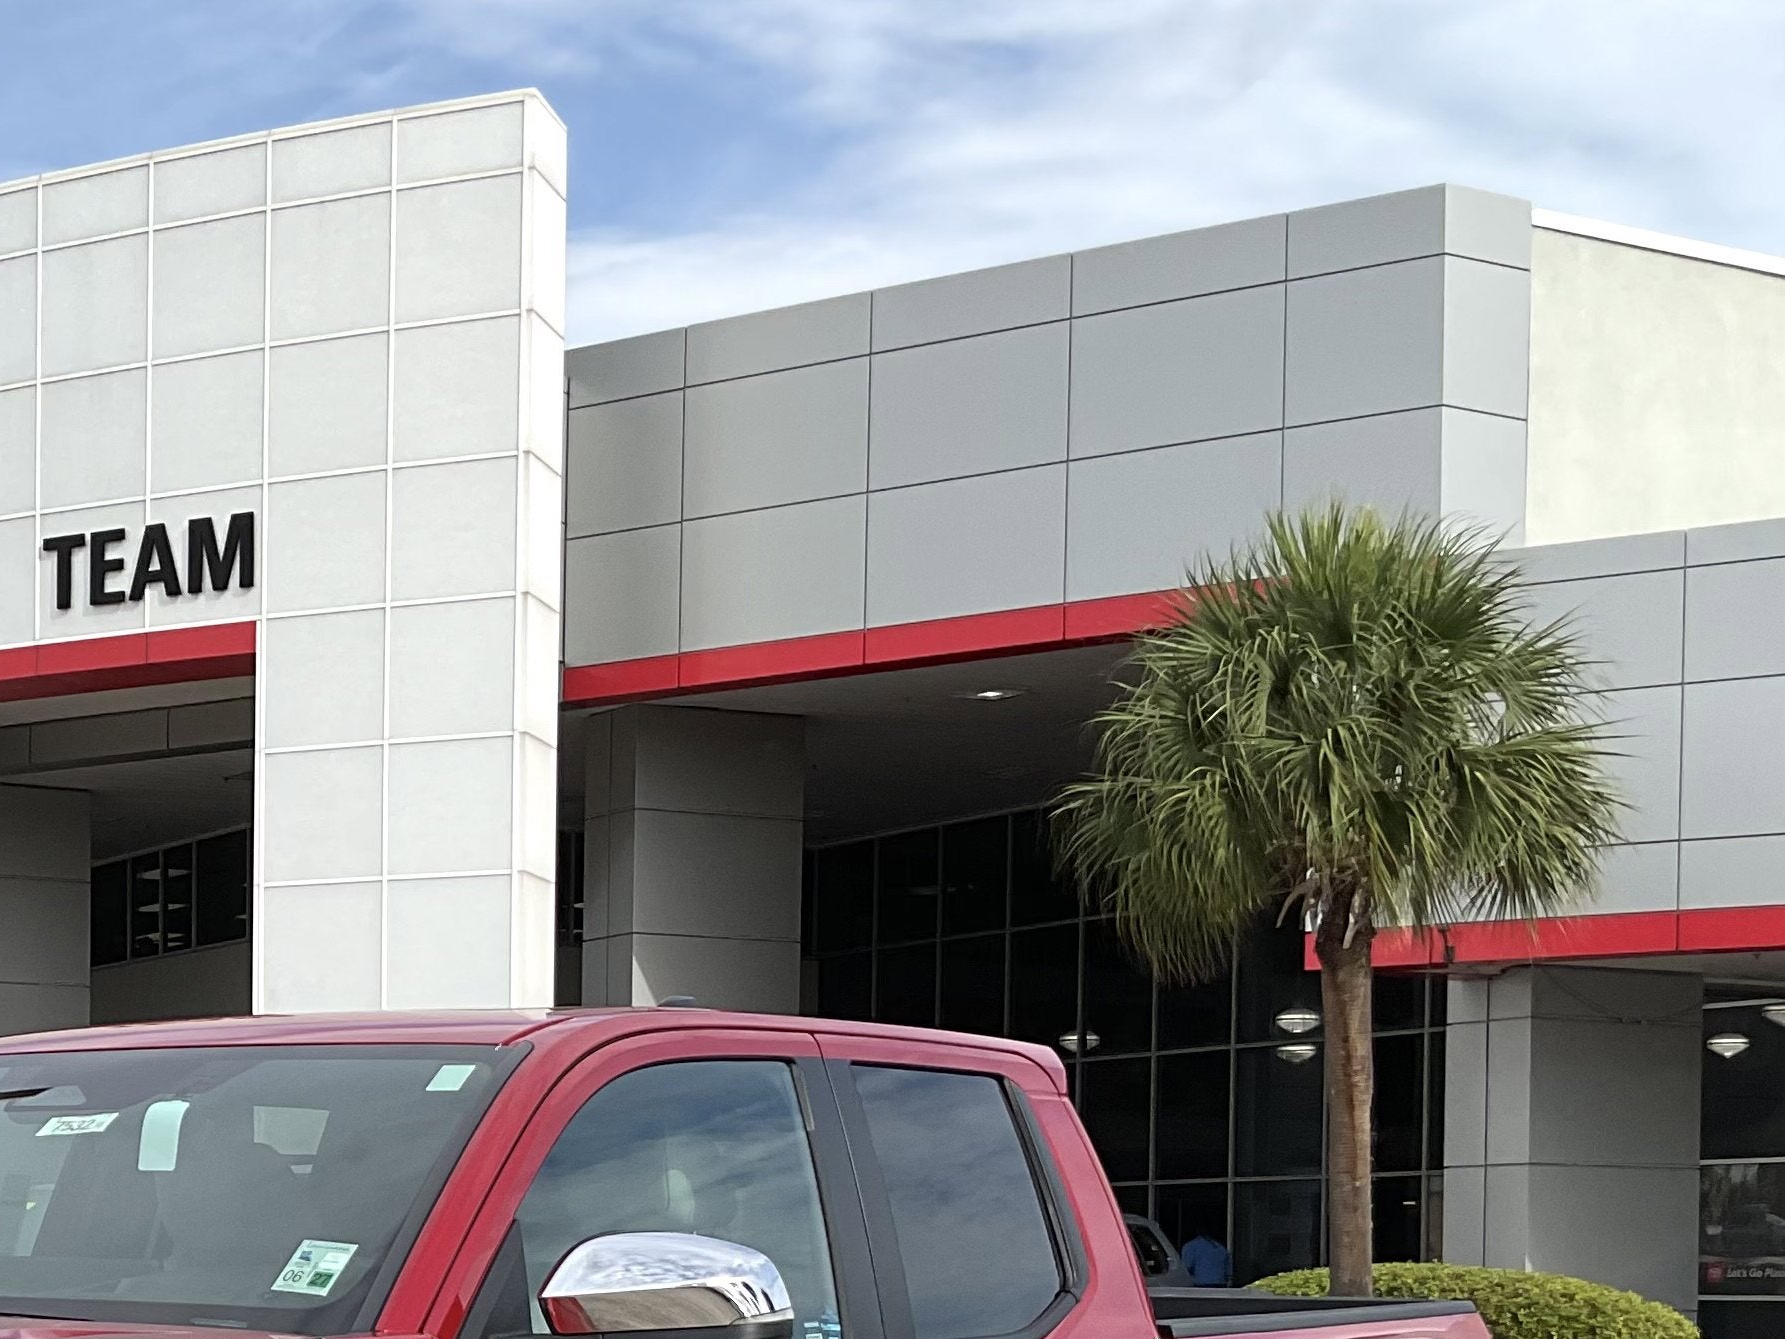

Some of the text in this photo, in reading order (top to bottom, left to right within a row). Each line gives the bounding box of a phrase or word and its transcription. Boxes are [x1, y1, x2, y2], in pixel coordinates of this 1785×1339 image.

[42, 511, 255, 610] TEAM
[282, 1269, 334, 1288] 06 27
